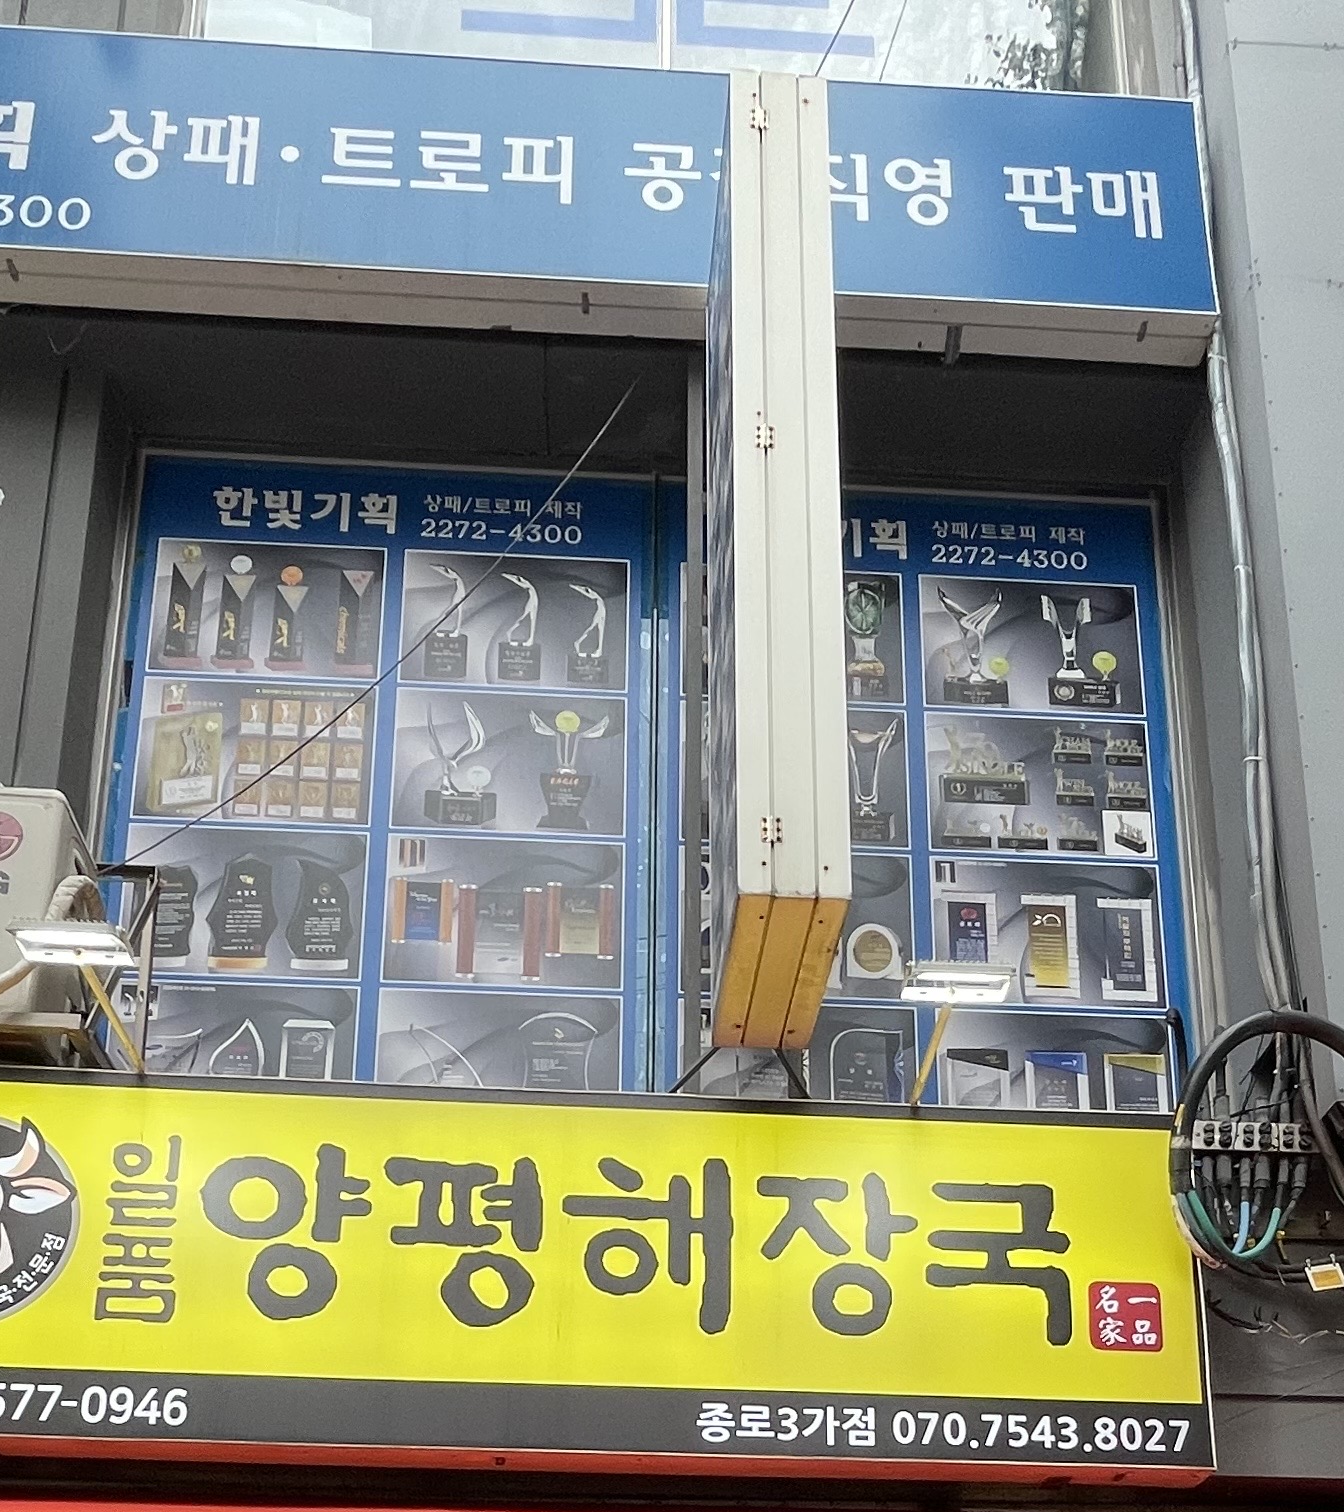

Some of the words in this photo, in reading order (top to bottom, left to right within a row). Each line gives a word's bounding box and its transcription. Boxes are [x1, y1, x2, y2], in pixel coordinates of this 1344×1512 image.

[92, 109, 573, 203] 상패·트로피
[624, 141, 955, 227] 공직영
[1002, 164, 1165, 239] 판매
[213, 485, 399, 535] 한빛기획
[423, 493, 532, 518] 상패/트로피
[545, 501, 583, 521] 제작
[420, 517, 583, 546] 2272-4300
[932, 520, 1037, 543] 상패/트로피
[1049, 525, 1086, 547] 제작
[931, 543, 1088, 571] 2272-4300
[201, 1142, 1074, 1347] 양평해장국
[695, 1401, 877, 1445] 종로3가점
[891, 1410, 1191, 1454] 070.7543.8027
